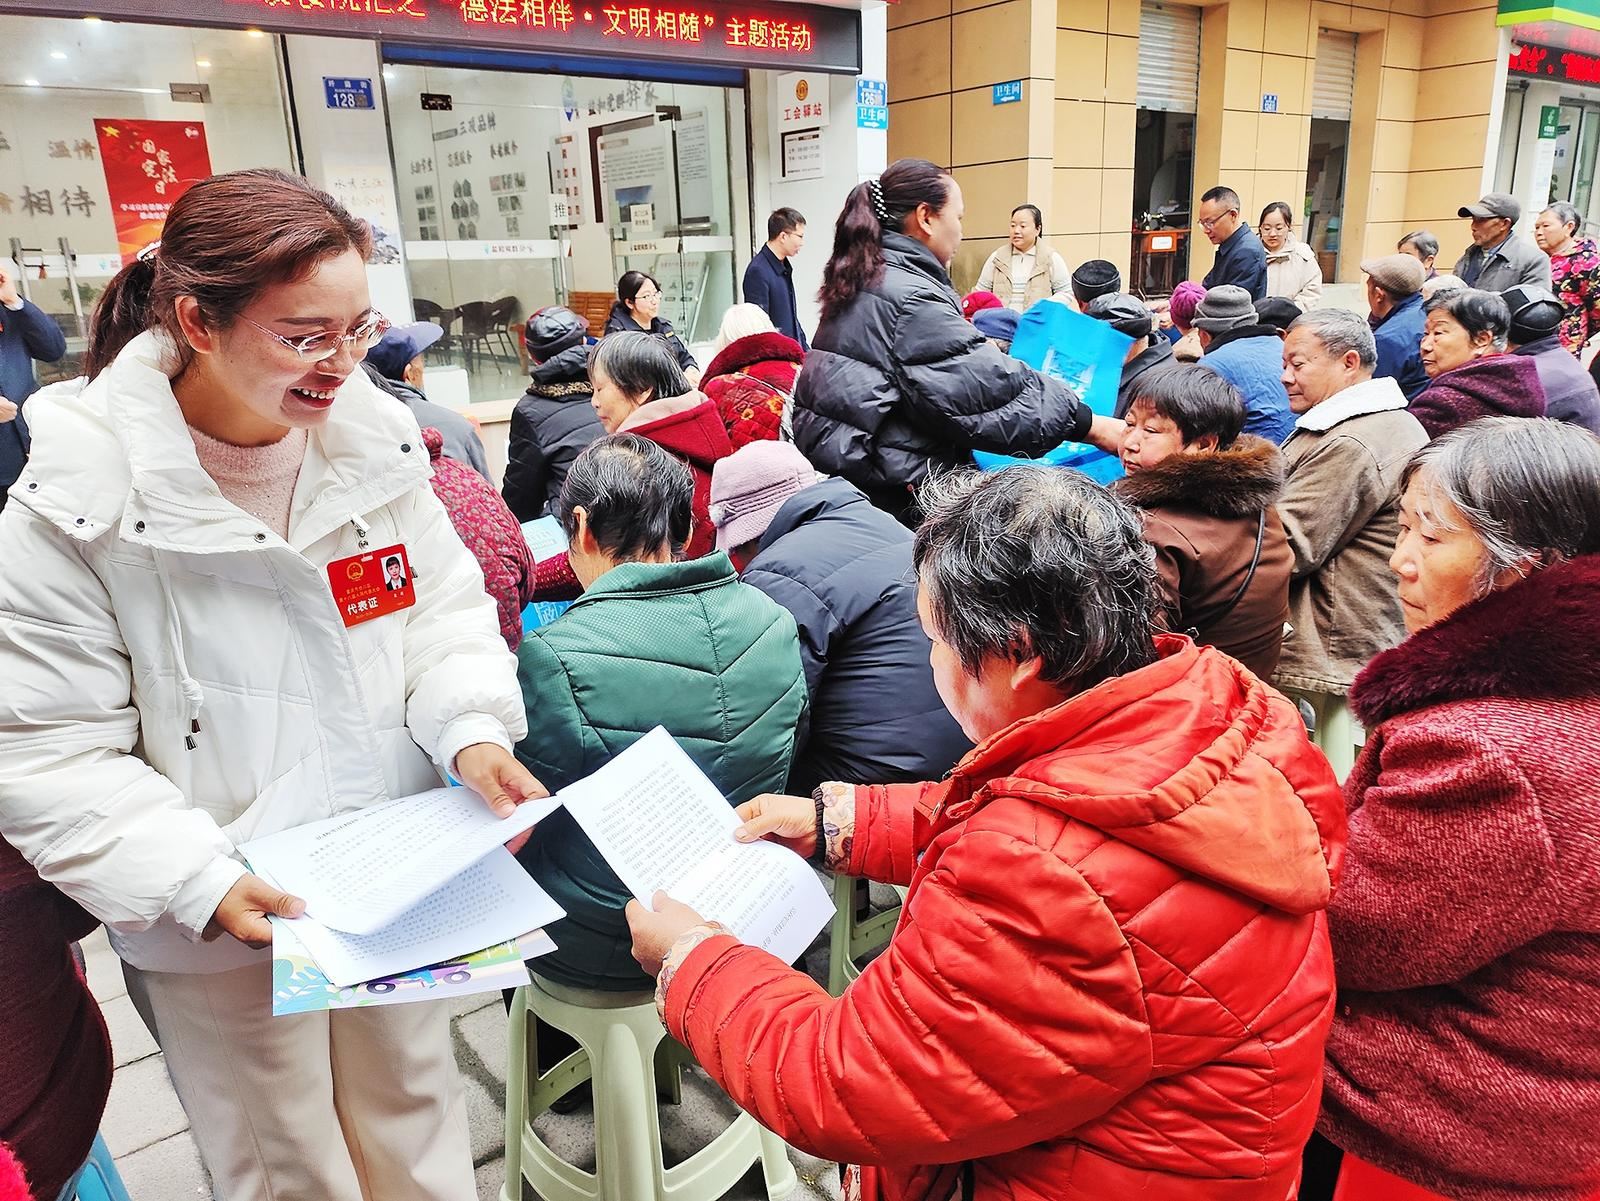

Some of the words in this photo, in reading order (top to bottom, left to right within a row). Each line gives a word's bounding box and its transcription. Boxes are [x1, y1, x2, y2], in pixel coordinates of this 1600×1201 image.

[996, 82, 1020, 96] 卫生间
[333, 93, 356, 107] 128
[859, 108, 886, 121] 卫生间
[554, 202, 567, 218] 推
[347, 596, 379, 616] 代表证
